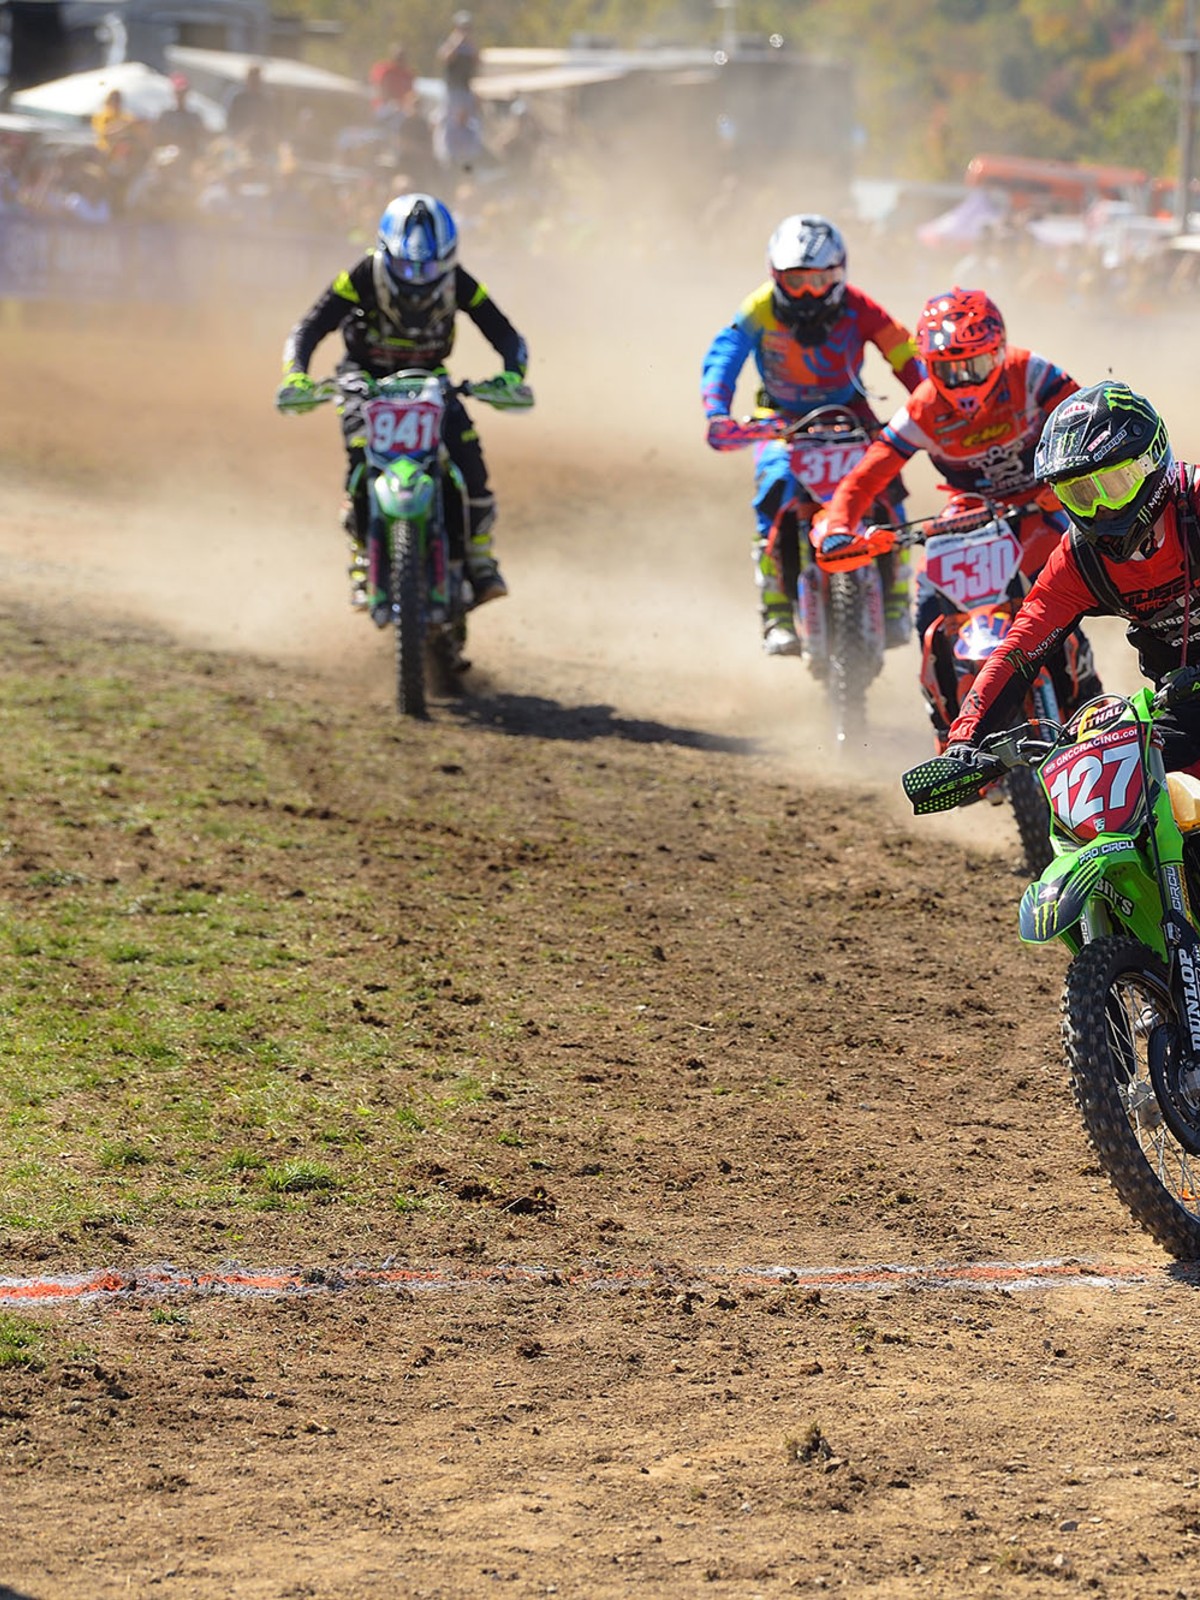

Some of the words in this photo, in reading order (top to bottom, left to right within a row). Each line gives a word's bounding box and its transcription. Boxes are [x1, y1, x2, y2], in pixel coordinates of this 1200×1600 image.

[372, 410, 434, 453] 941
[941, 540, 1015, 602] 530
[1056, 728, 1139, 767] GNCCRACING.co
[1050, 742, 1141, 830] 127
[1078, 847, 1099, 867] PRO
